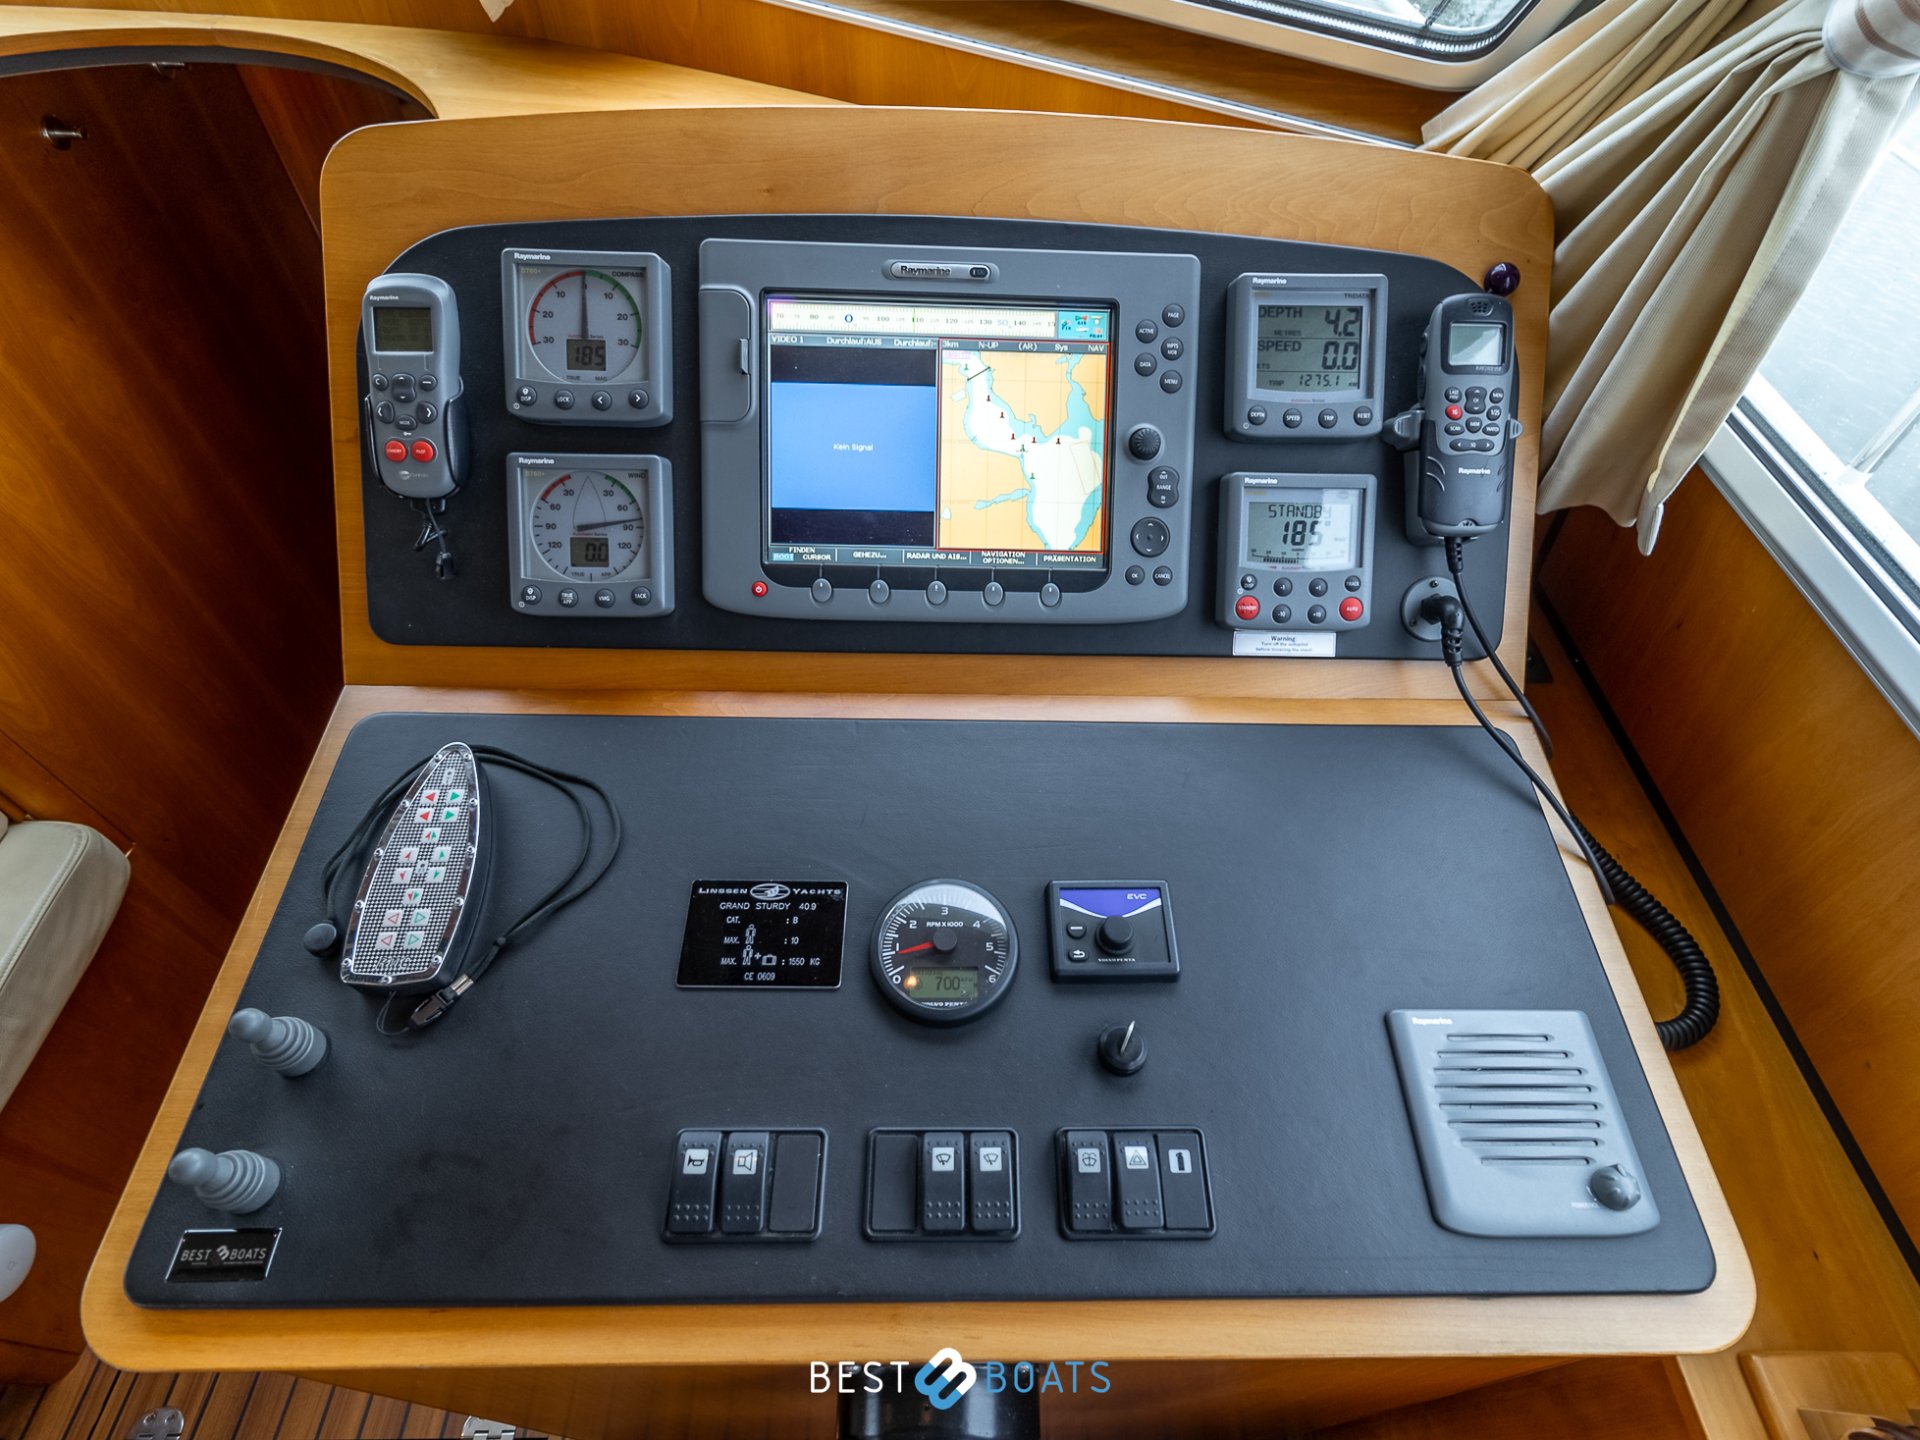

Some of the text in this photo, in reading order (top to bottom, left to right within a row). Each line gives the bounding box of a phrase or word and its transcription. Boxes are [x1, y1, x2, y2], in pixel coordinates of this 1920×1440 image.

[900, 265, 951, 277] Raymarine
[1259, 306, 1302, 318] DEPTH
[1324, 308, 1360, 337] 4.2
[1055, 344, 1068, 352] Sys
[1258, 340, 1302, 352] SPEED
[575, 346, 604, 366] 185
[1322, 341, 1358, 370] 0.0
[1299, 374, 1340, 387] 1275.1
[1458, 467, 1491, 475] Raymarine
[1268, 504, 1332, 518] STANDBY
[941, 907, 948, 915] 3
[909, 920, 917, 929] 2
[973, 920, 980, 928] 4
[724, 936, 739, 944] MAX.
[986, 943, 993, 951] 5
[744, 972, 753, 980] CE
[893, 975, 901, 984] 0
[989, 975, 996, 983] 6
[936, 976, 960, 990] 700
[1412, 1017, 1453, 1025] Raymarine
[180, 1248, 267, 1261] BEST BOATS
